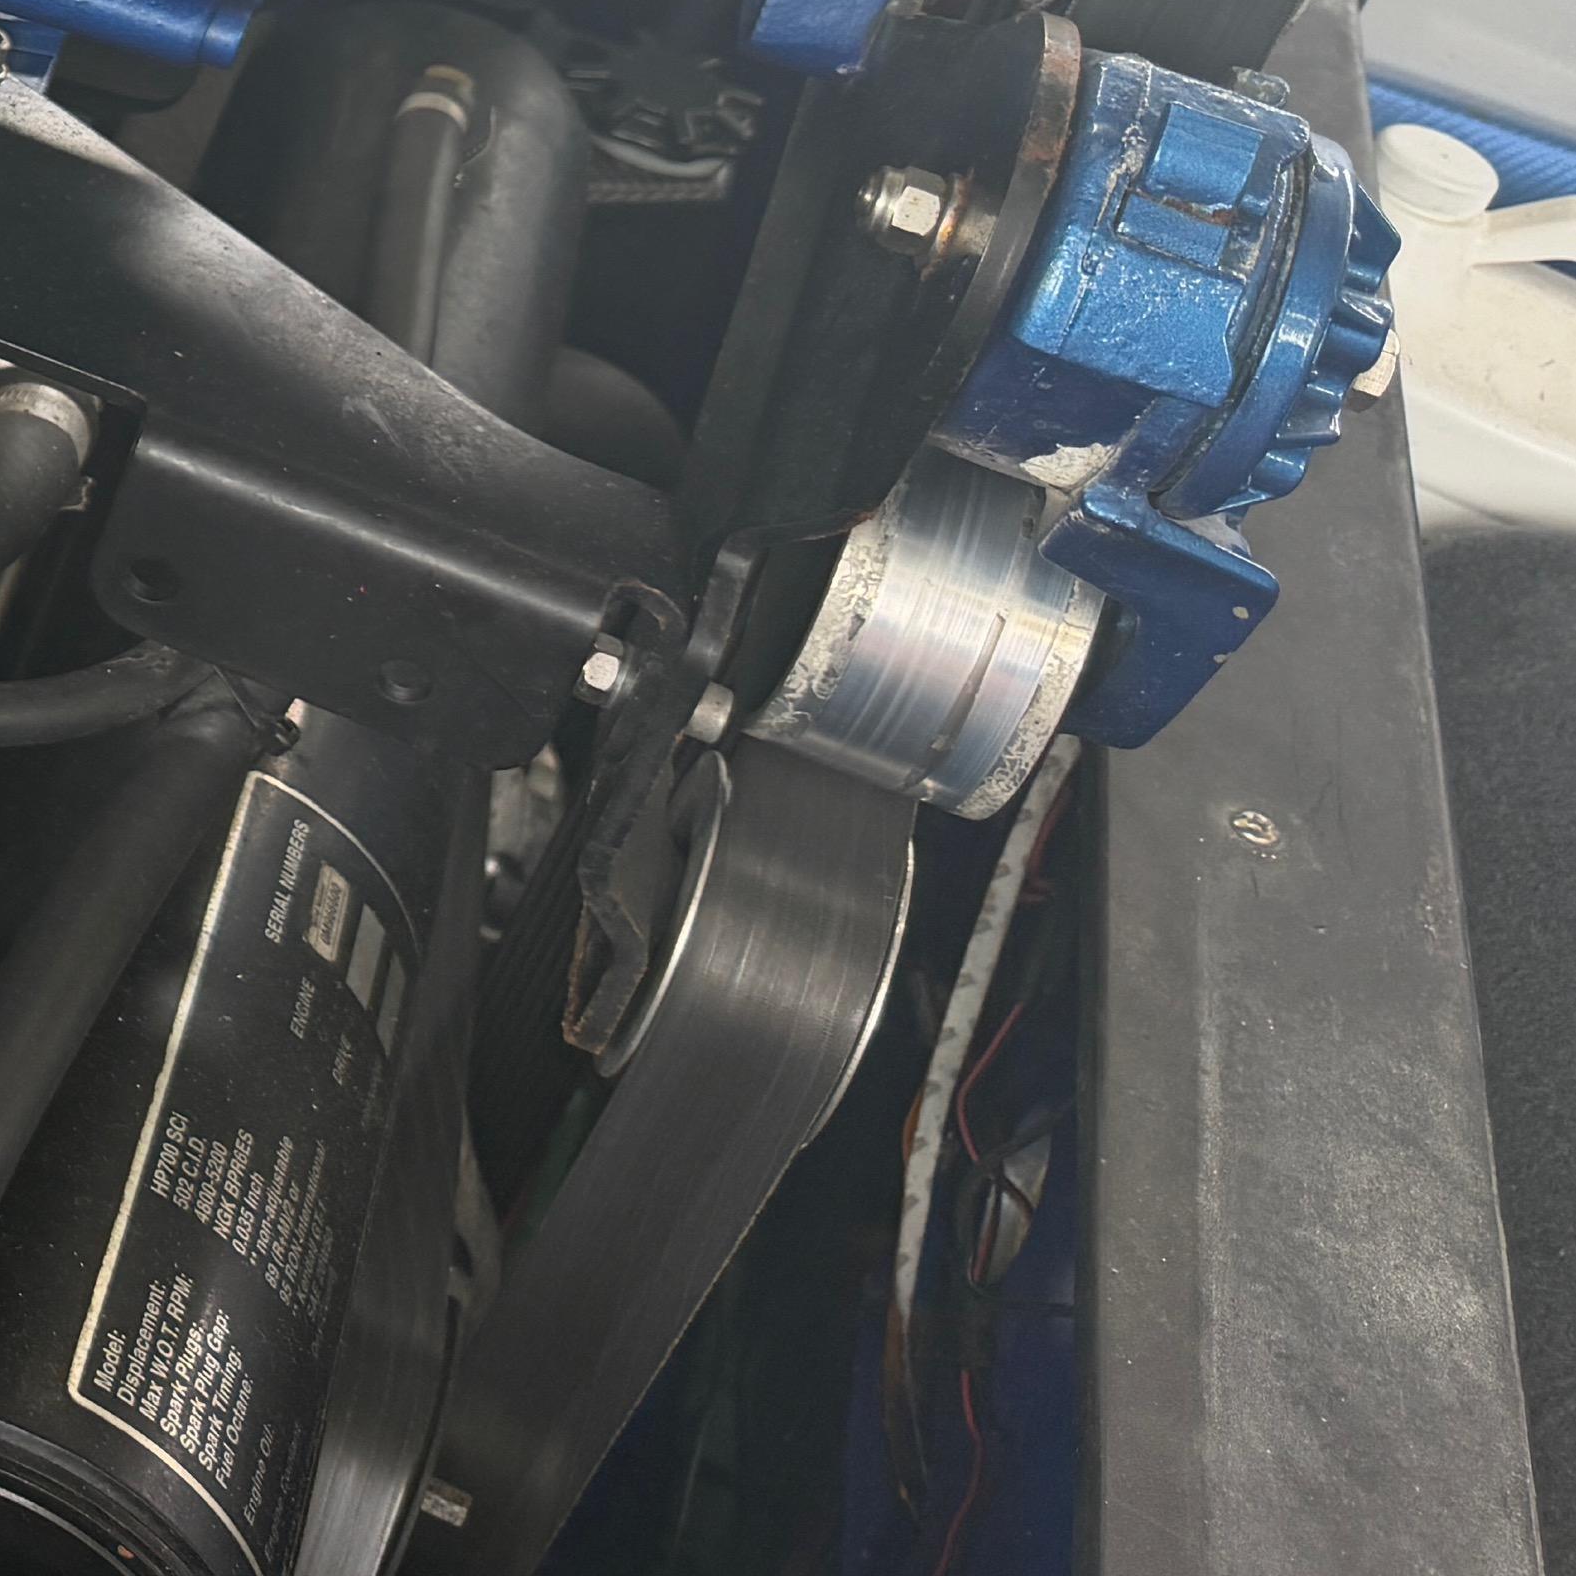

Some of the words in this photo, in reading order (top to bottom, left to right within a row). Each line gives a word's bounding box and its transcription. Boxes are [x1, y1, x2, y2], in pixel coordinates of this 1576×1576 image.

[264, 891, 291, 944] SERIAL
[278, 819, 310, 894] NUMBERS
[290, 976, 316, 1039] ENGINE
[182, 1136, 208, 1178] C.I.D.
[194, 1140, 227, 1224] 4800-5200
[212, 1194, 236, 1240] NGK
[224, 1128, 254, 1200] BPR6ES
[172, 1177, 194, 1211] 502
[256, 1135, 294, 1256] non-adjustable
[232, 1206, 255, 1256] 0.035
[265, 1262, 280, 1290] 89
[289, 1179, 300, 1202] or
[93, 1329, 126, 1393] Model:
[150, 1142, 179, 1199] HP700
[166, 1272, 194, 1323] RPM:
[279, 1279, 293, 1307] 95
[116, 1279, 167, 1407] Displacement:
[150, 1321, 180, 1380] W.O.T.
[206, 1309, 231, 1355] Gap:
[138, 1380, 164, 1422] Max
[160, 1379, 188, 1437] Spark
[175, 1321, 206, 1381] Plugs:
[194, 1352, 221, 1400] Plug
[198, 1413, 224, 1472] Spark
[212, 1344, 243, 1414] Timing:
[179, 1396, 207, 1455] Spark
[215, 1442, 236, 1490] Fuel
[226, 1373, 254, 1446] Octane:
[244, 1458, 267, 1526] Engine
